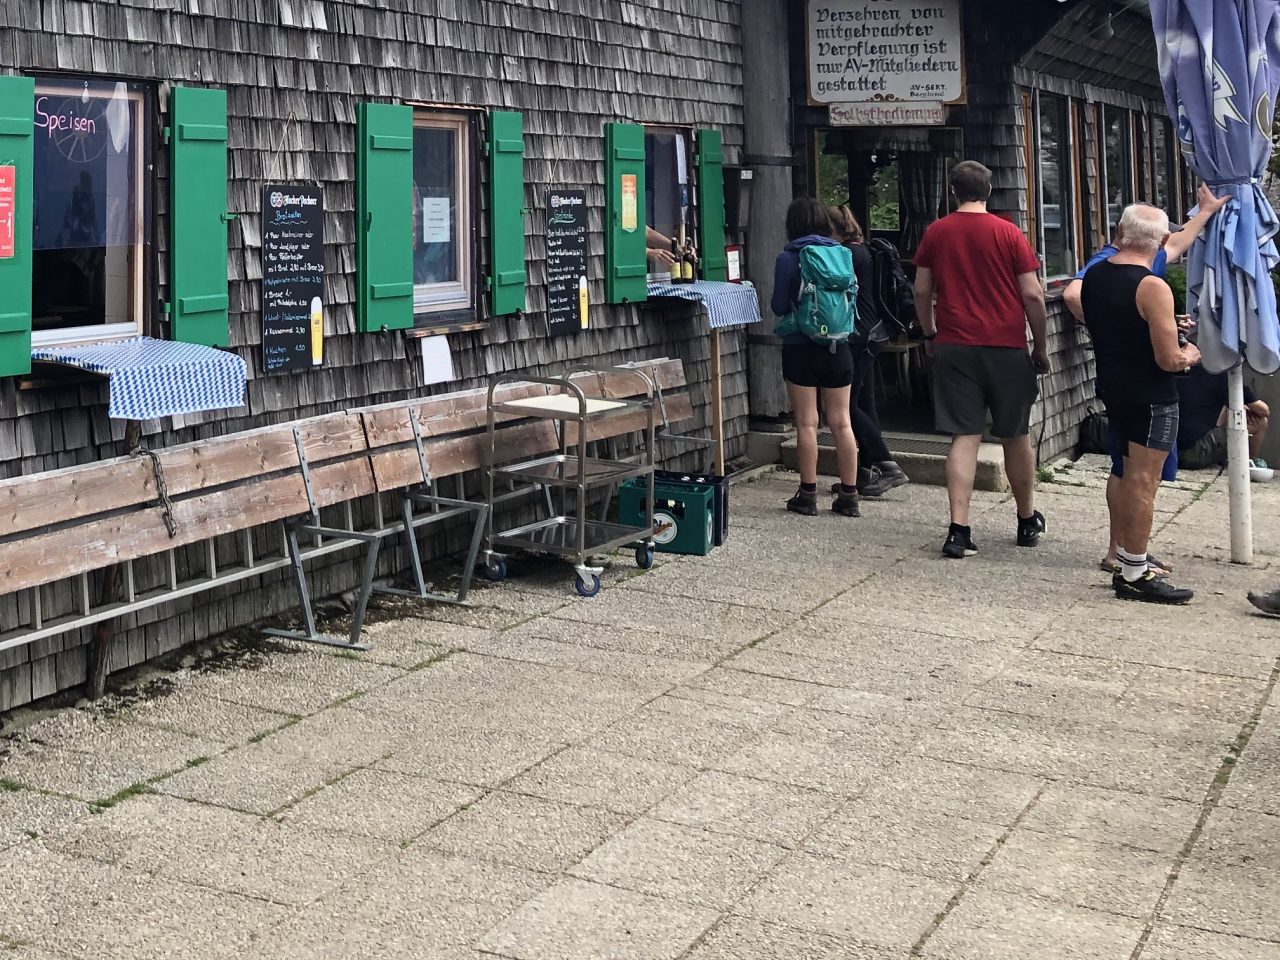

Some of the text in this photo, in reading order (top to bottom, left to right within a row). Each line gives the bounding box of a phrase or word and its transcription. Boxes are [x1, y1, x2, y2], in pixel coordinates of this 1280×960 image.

[816, 4, 945, 22] Verzehren von
[815, 22, 934, 41] mitgebrachter
[818, 39, 948, 57] Verpflegung ist
[816, 55, 959, 75] nur AV-Mitgliedern
[816, 74, 887, 96] gestattet
[33, 96, 96, 139] Speisen
[831, 107, 944, 124] Selbstbedienung
